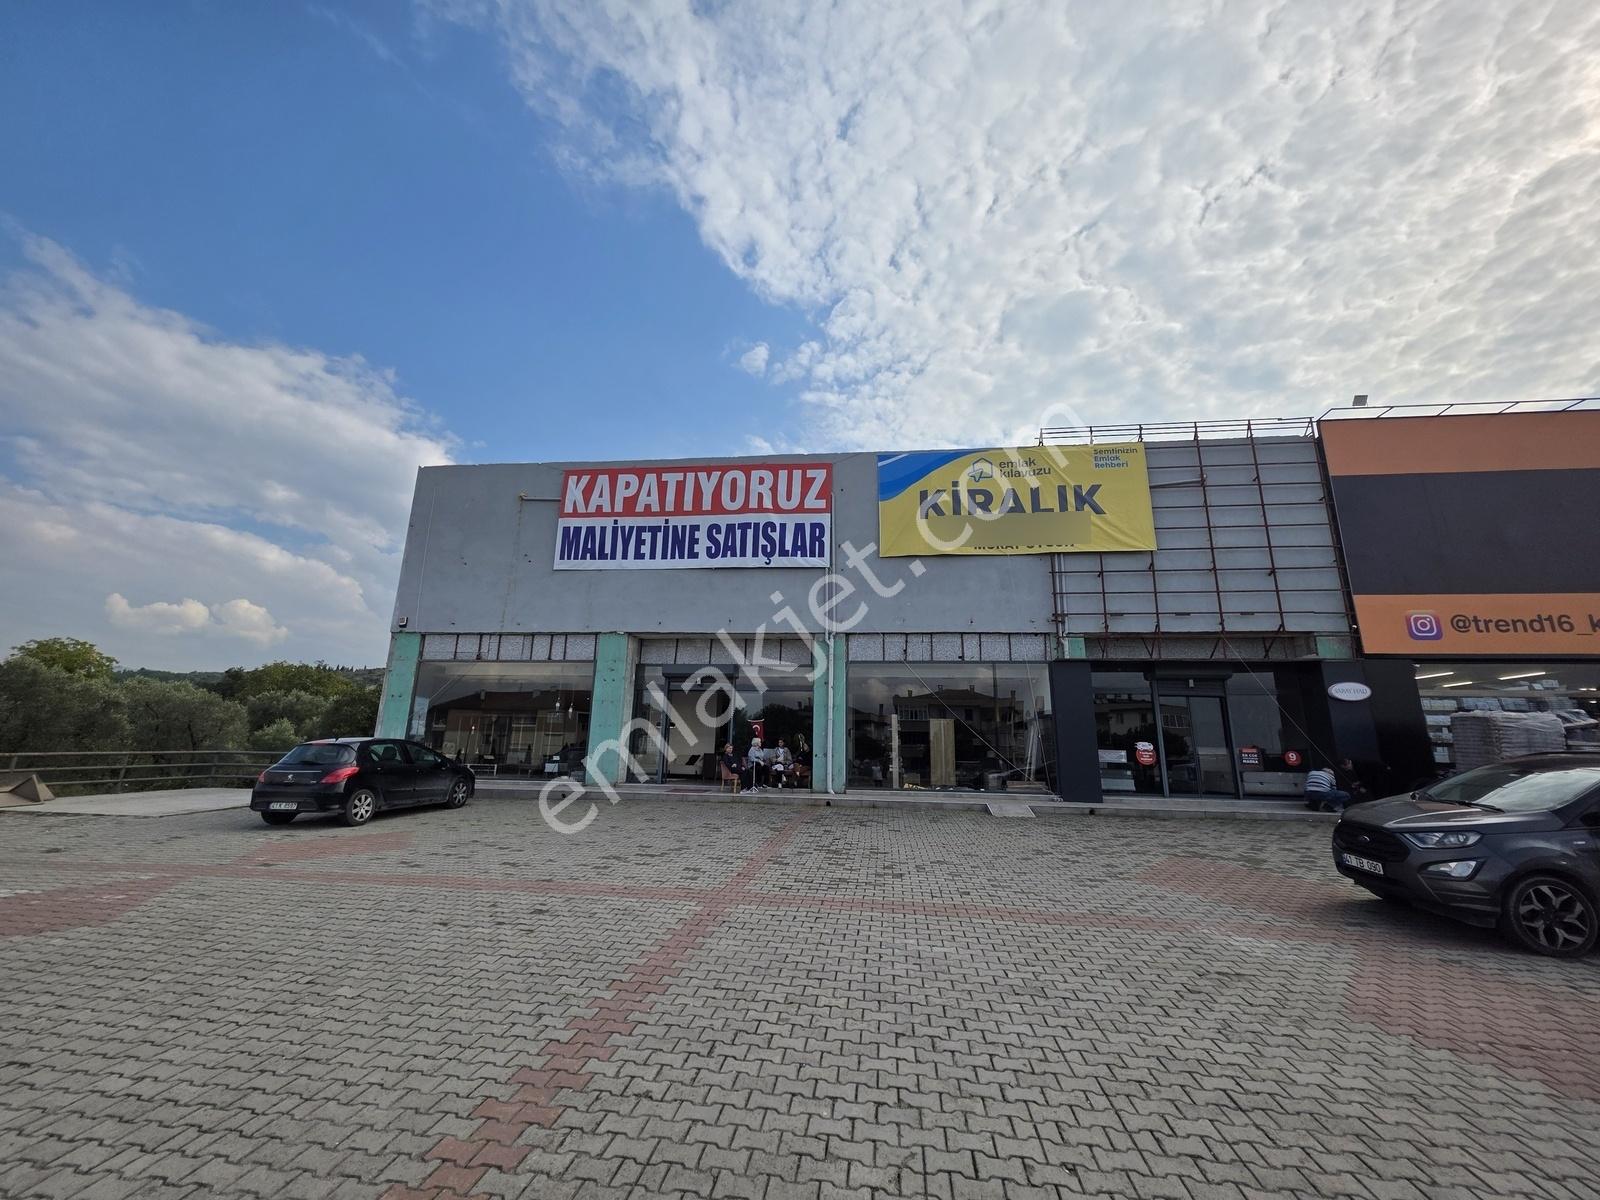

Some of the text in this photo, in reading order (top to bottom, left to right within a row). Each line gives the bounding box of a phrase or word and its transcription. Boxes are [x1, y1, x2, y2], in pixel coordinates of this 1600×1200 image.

[1094, 447, 1138, 455] Semtinizin
[998, 456, 1037, 469] emlak
[1095, 461, 1129, 469] Rehberi
[563, 468, 827, 514] KAPATIYORUZ
[919, 480, 1107, 520] KİRALIK
[559, 518, 826, 566] MALİYETİNE SATIŞLAR
[1355, 857, 1365, 868] TB
[1366, 860, 1382, 873] 090
